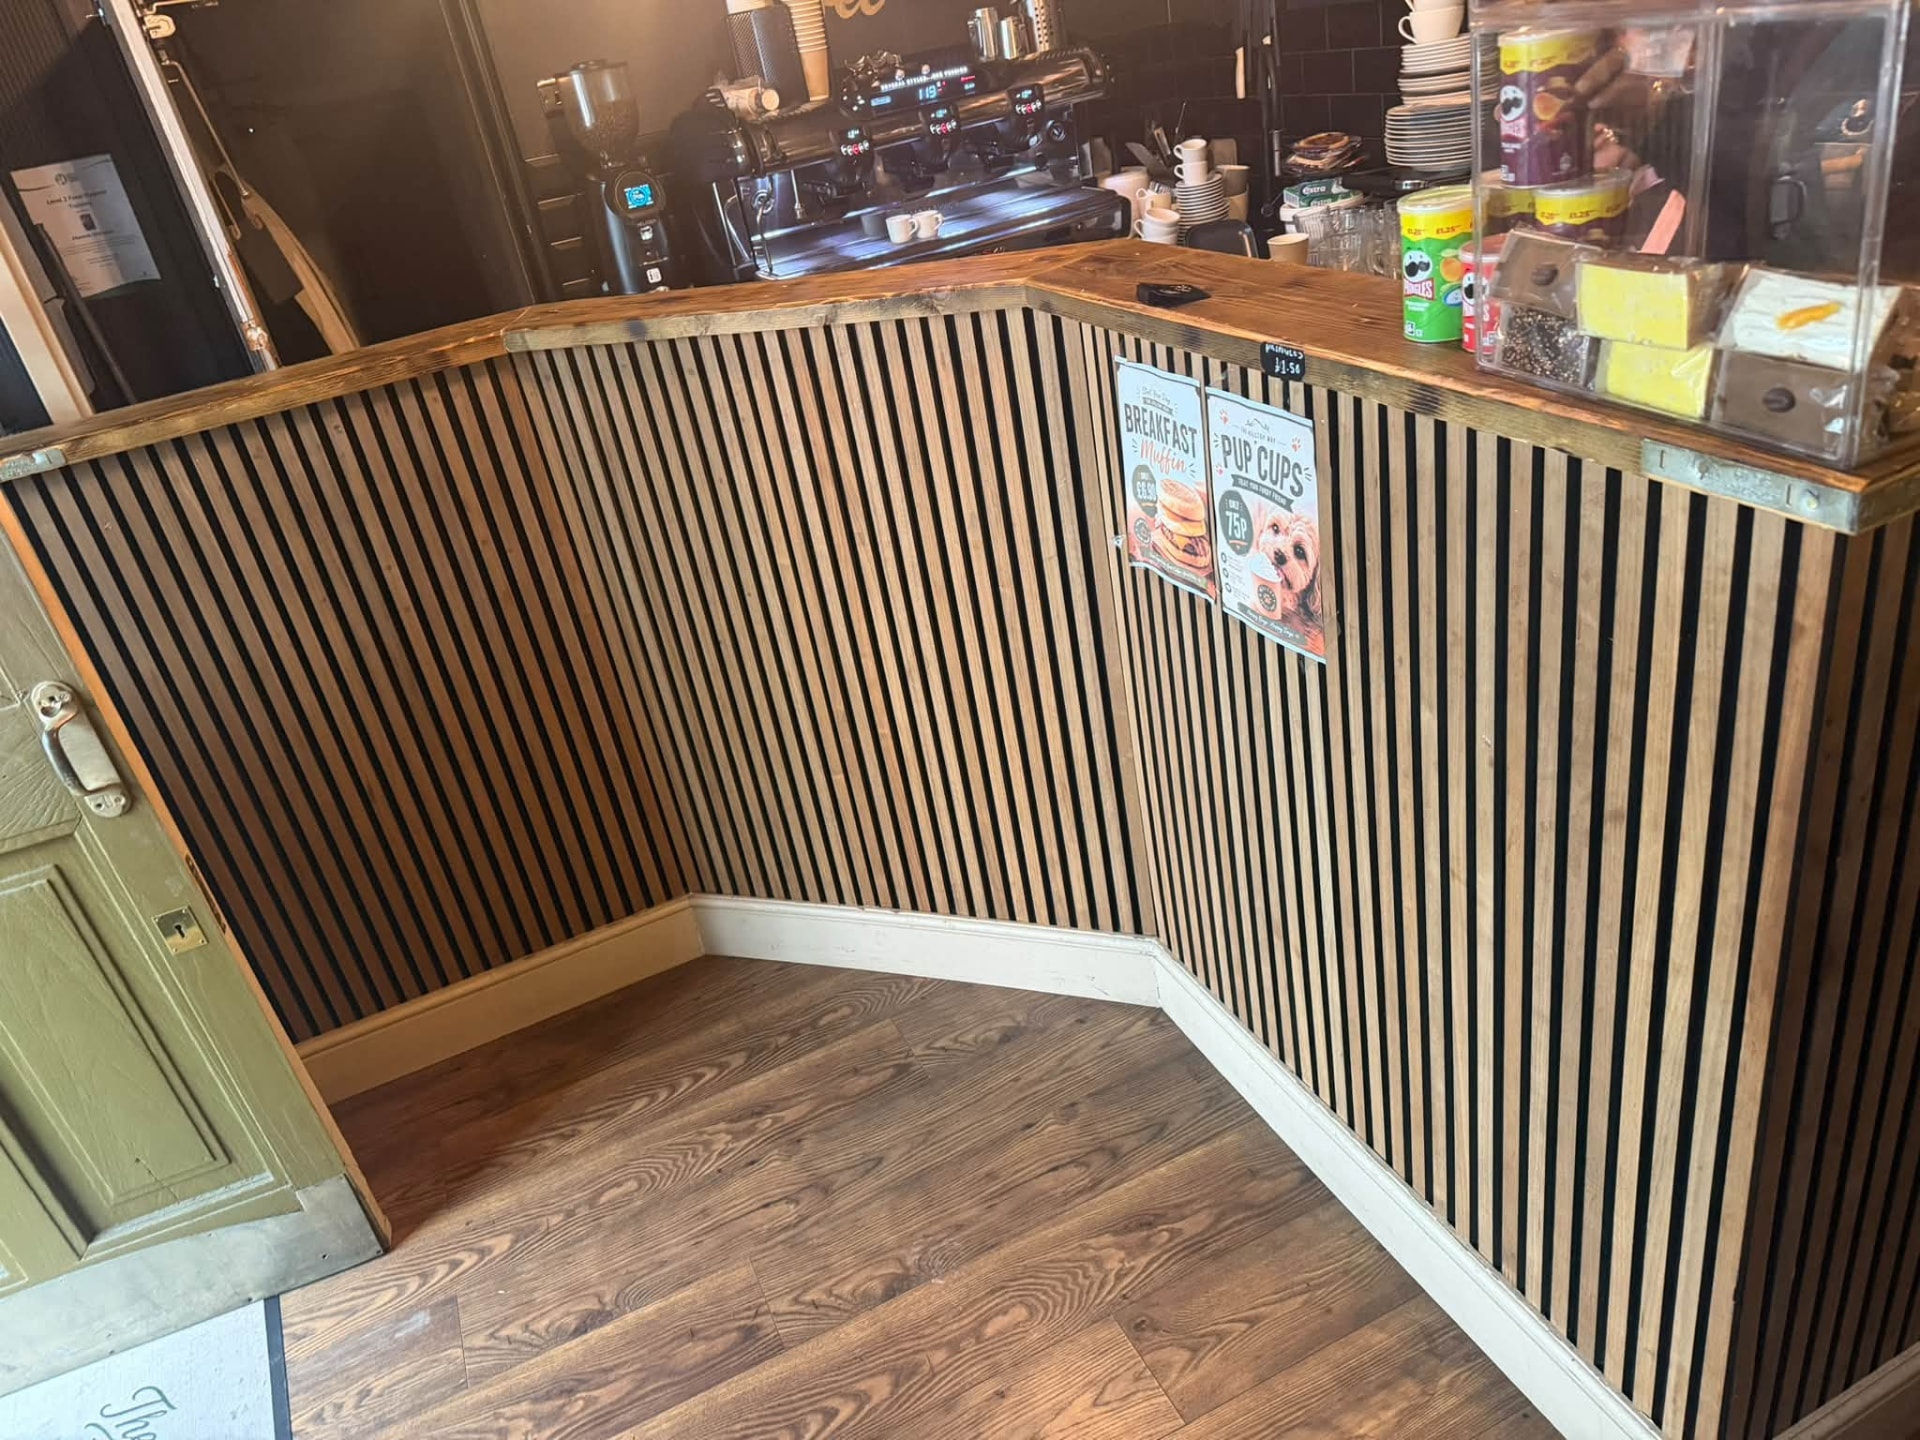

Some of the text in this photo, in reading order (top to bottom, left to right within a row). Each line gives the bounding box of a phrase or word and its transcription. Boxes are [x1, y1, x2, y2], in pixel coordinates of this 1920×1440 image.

[1124, 403, 1197, 458] BREAKFAST
[1140, 438, 1186, 475] Muffin
[1221, 434, 1304, 498] PUP CUPS
[1225, 510, 1247, 540] 75P
